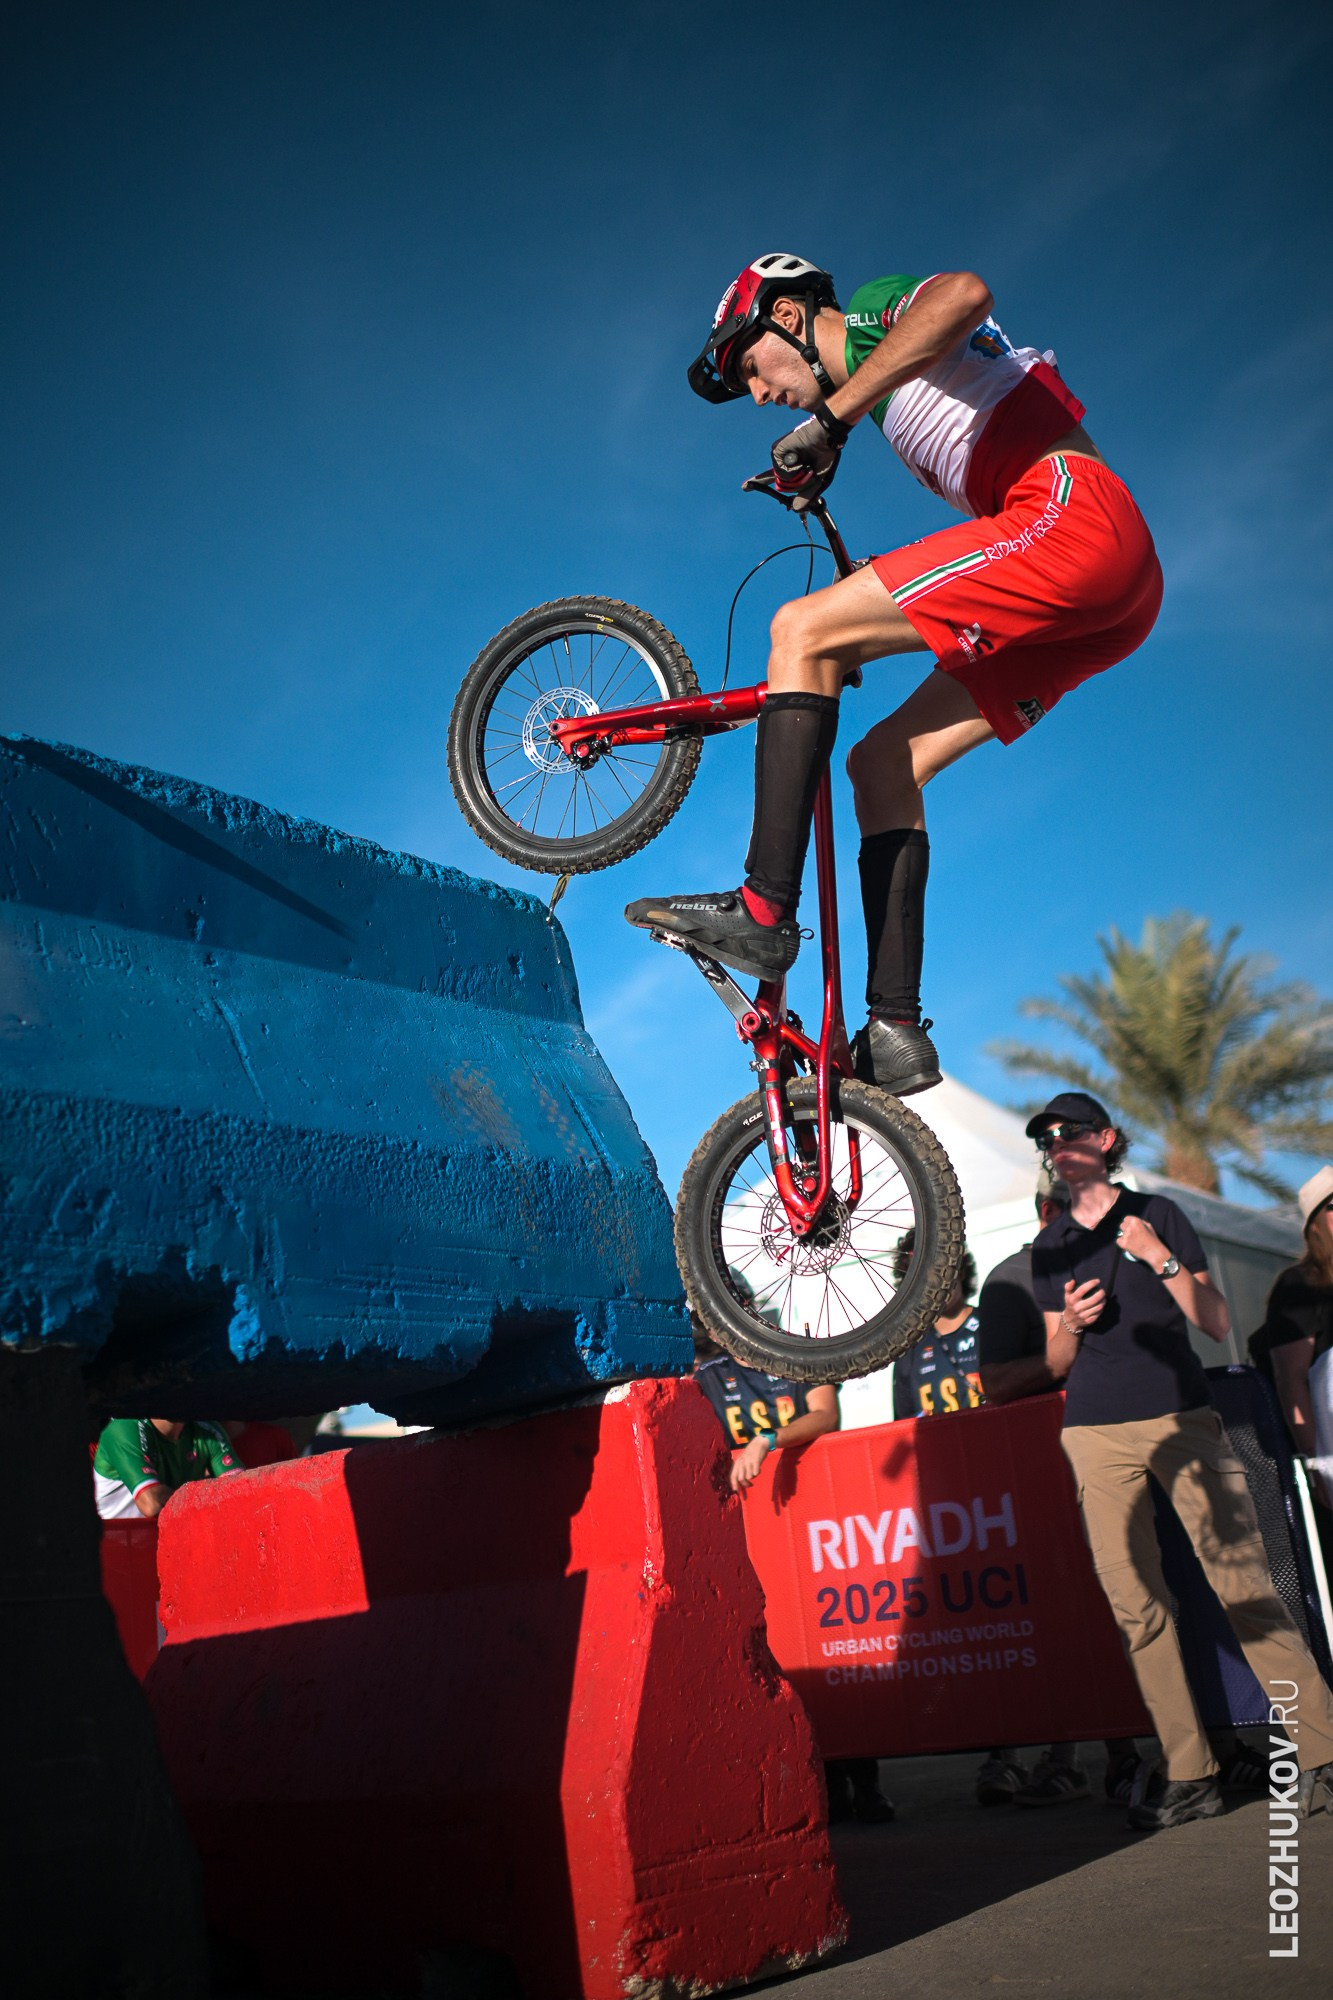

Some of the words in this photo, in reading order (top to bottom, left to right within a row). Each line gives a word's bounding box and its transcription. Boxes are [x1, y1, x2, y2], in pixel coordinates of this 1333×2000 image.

[807, 1492, 1018, 1574] RIYADH
[816, 1576, 929, 1629] 2025
[939, 1563, 1029, 1614] UCI
[821, 1635, 883, 1657] URBAN
[884, 1627, 963, 1653] CYCLING
[964, 1620, 1034, 1643] WORLD
[825, 1648, 1038, 1686] CHAMPIONSHIPS
